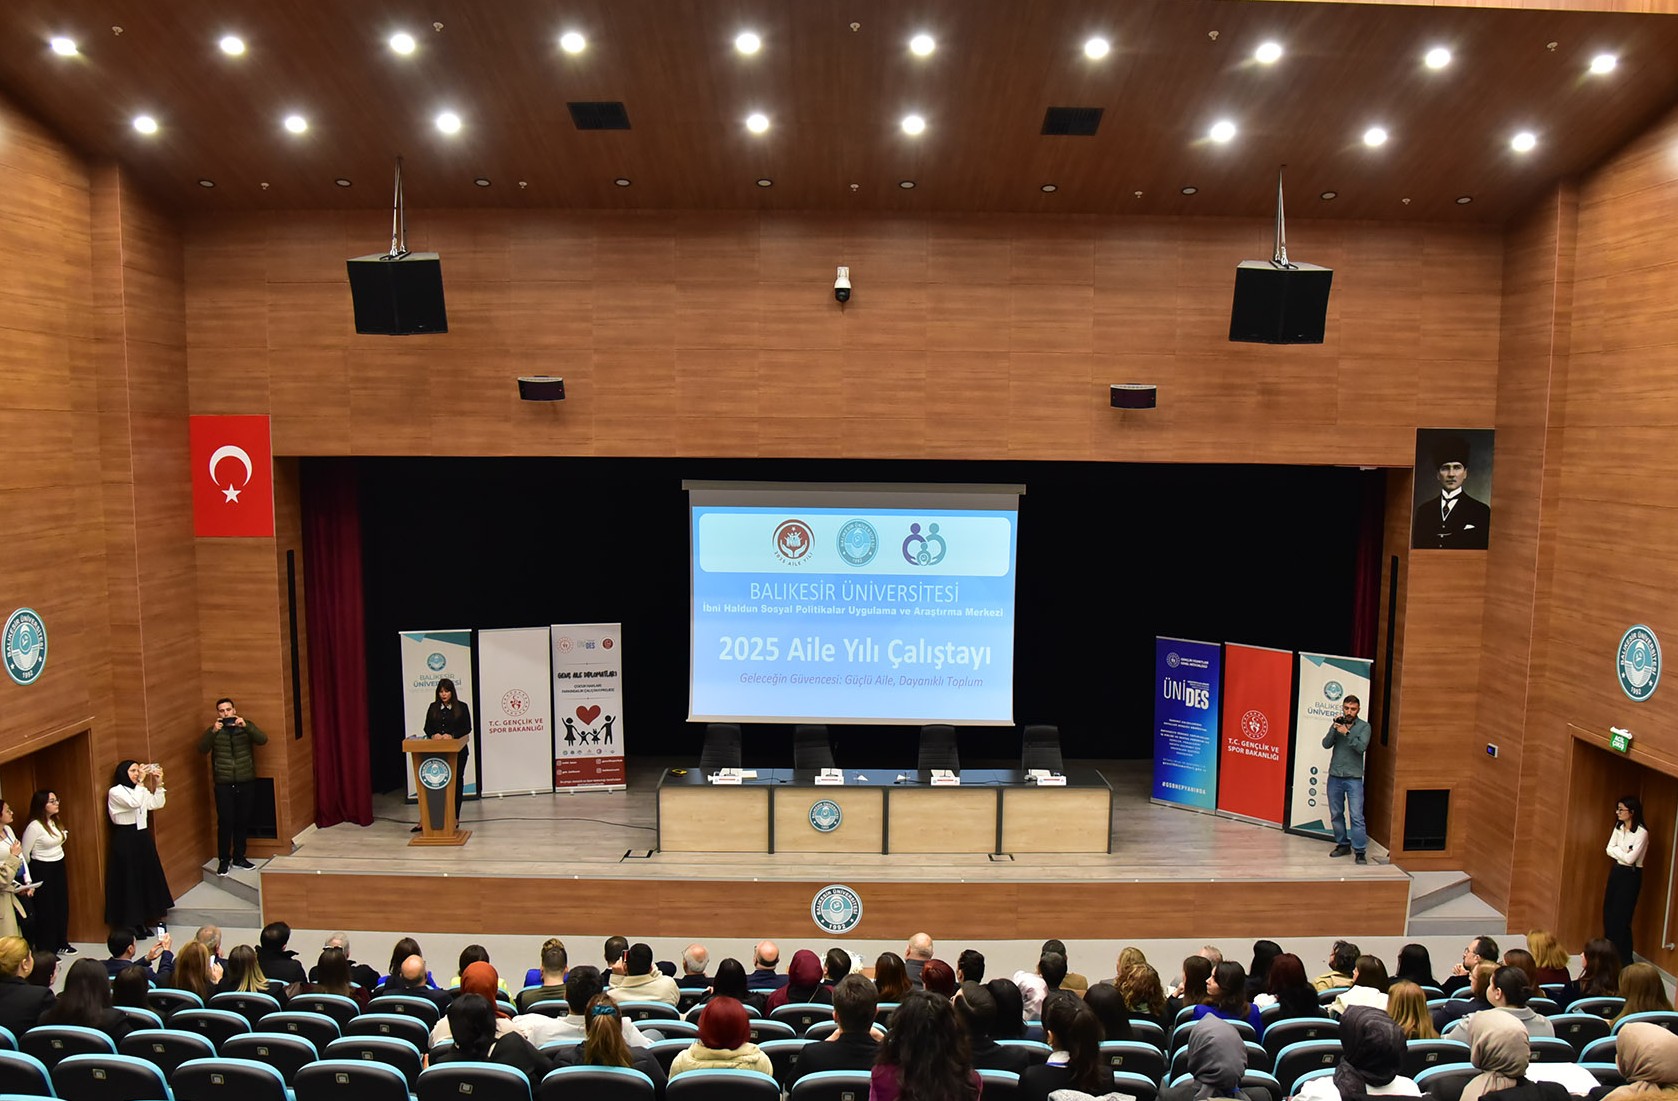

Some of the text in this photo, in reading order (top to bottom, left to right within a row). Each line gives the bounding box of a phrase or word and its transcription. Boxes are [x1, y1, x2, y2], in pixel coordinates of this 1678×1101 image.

[750, 580, 959, 603] BALIKESİR ÜNİVERSİTESİ
[703, 602, 721, 613] İbni
[724, 604, 758, 613] Haldun
[761, 604, 793, 615] Sosyal
[796, 605, 845, 614] Politikalar
[848, 606, 897, 617] Uygulama
[914, 607, 962, 617] Araştırma
[965, 607, 1003, 617] Merkezi
[719, 636, 991, 670] 2025 Aile Yılı Çalıştayı
[739, 672, 983, 689] Geleceğin Güvencesi: Güçlü Aile, Dayanıklı Toplum
[1630, 686, 1642, 695] 1992
[1315, 702, 1343, 711] BALIKES
[503, 718, 533, 726] GENÇLİK
[1241, 740, 1269, 751] GENÇLİK
[1228, 746, 1279, 761] SPOR BAKANLIĞI
[816, 888, 858, 915] BALIKESİR ÜNİVERSİTESİ
